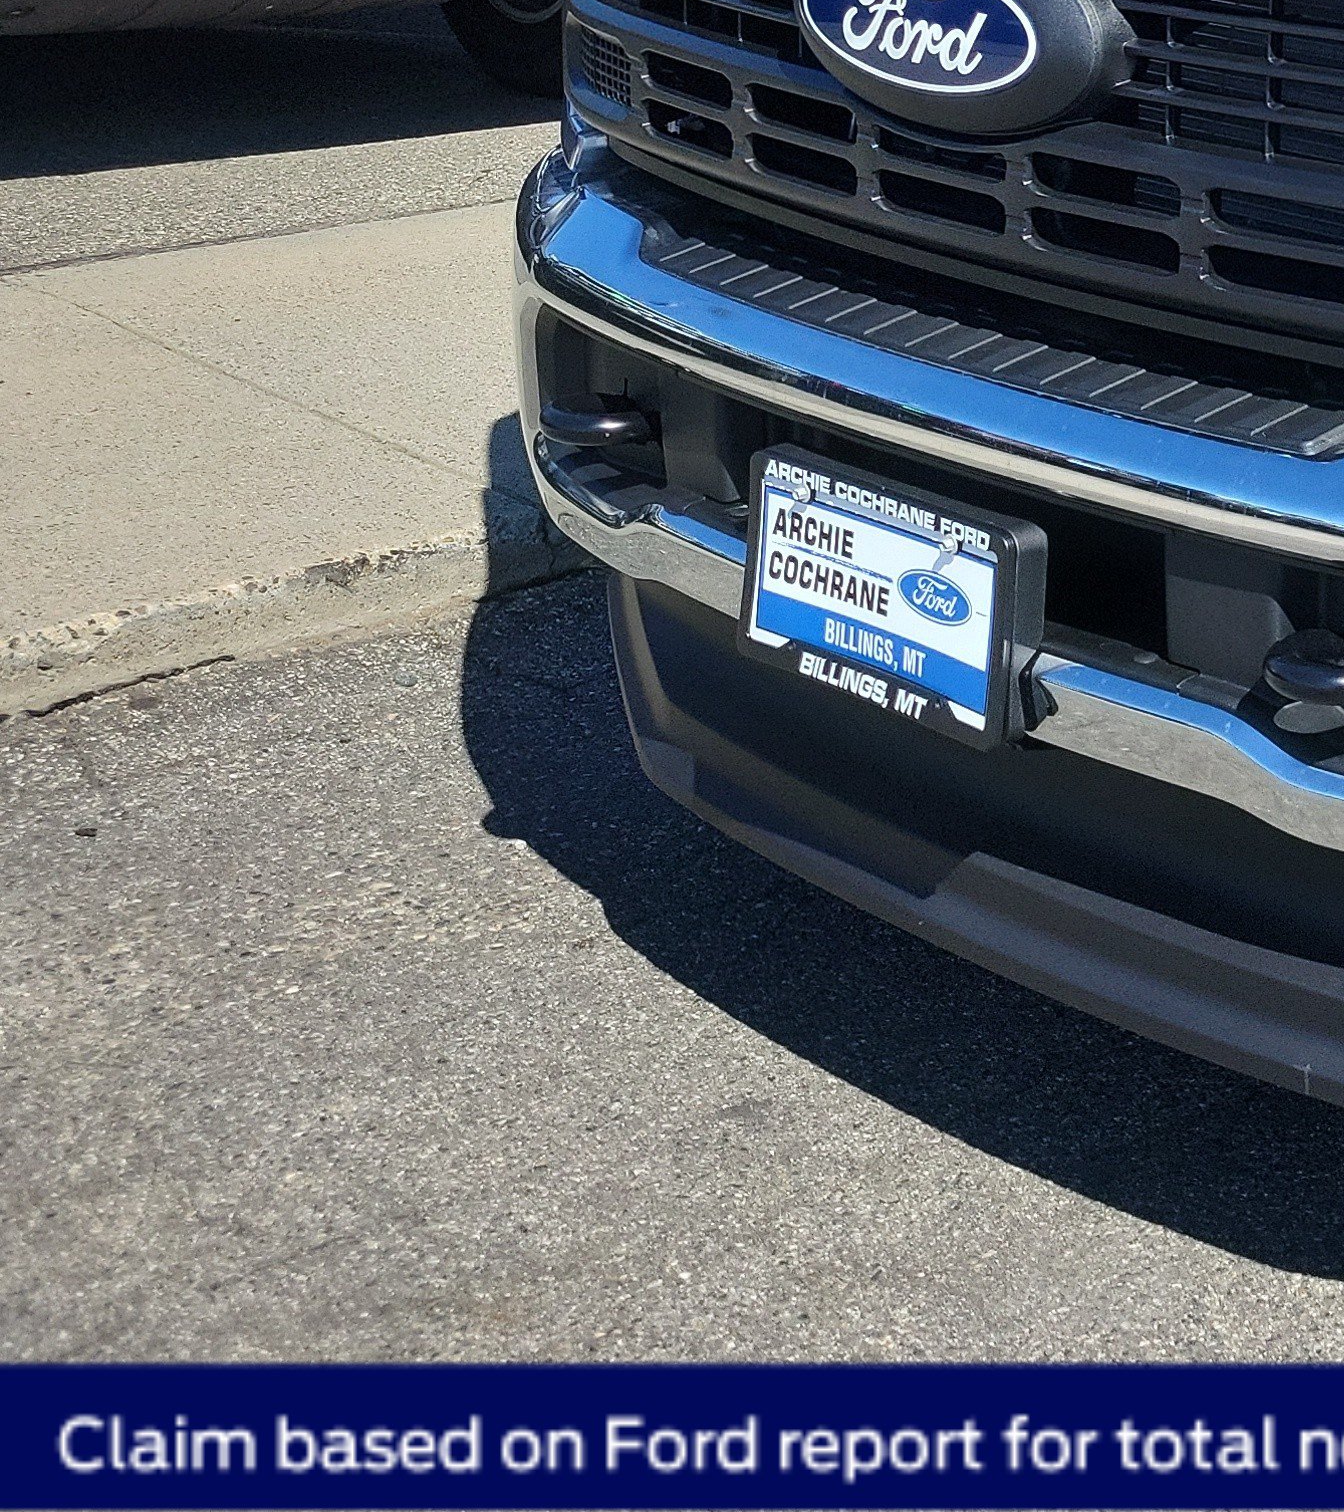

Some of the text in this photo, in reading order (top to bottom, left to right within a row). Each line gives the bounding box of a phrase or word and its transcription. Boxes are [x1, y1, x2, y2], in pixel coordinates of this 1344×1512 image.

[764, 459, 991, 551] ARCHIE COCHRANE FORD
[772, 508, 855, 560] ARCHIE
[768, 550, 890, 617] COCHRANE
[911, 574, 957, 619] Ford
[823, 617, 927, 678] BILLINGS, MT
[799, 651, 929, 720] BILLINGS, MT
